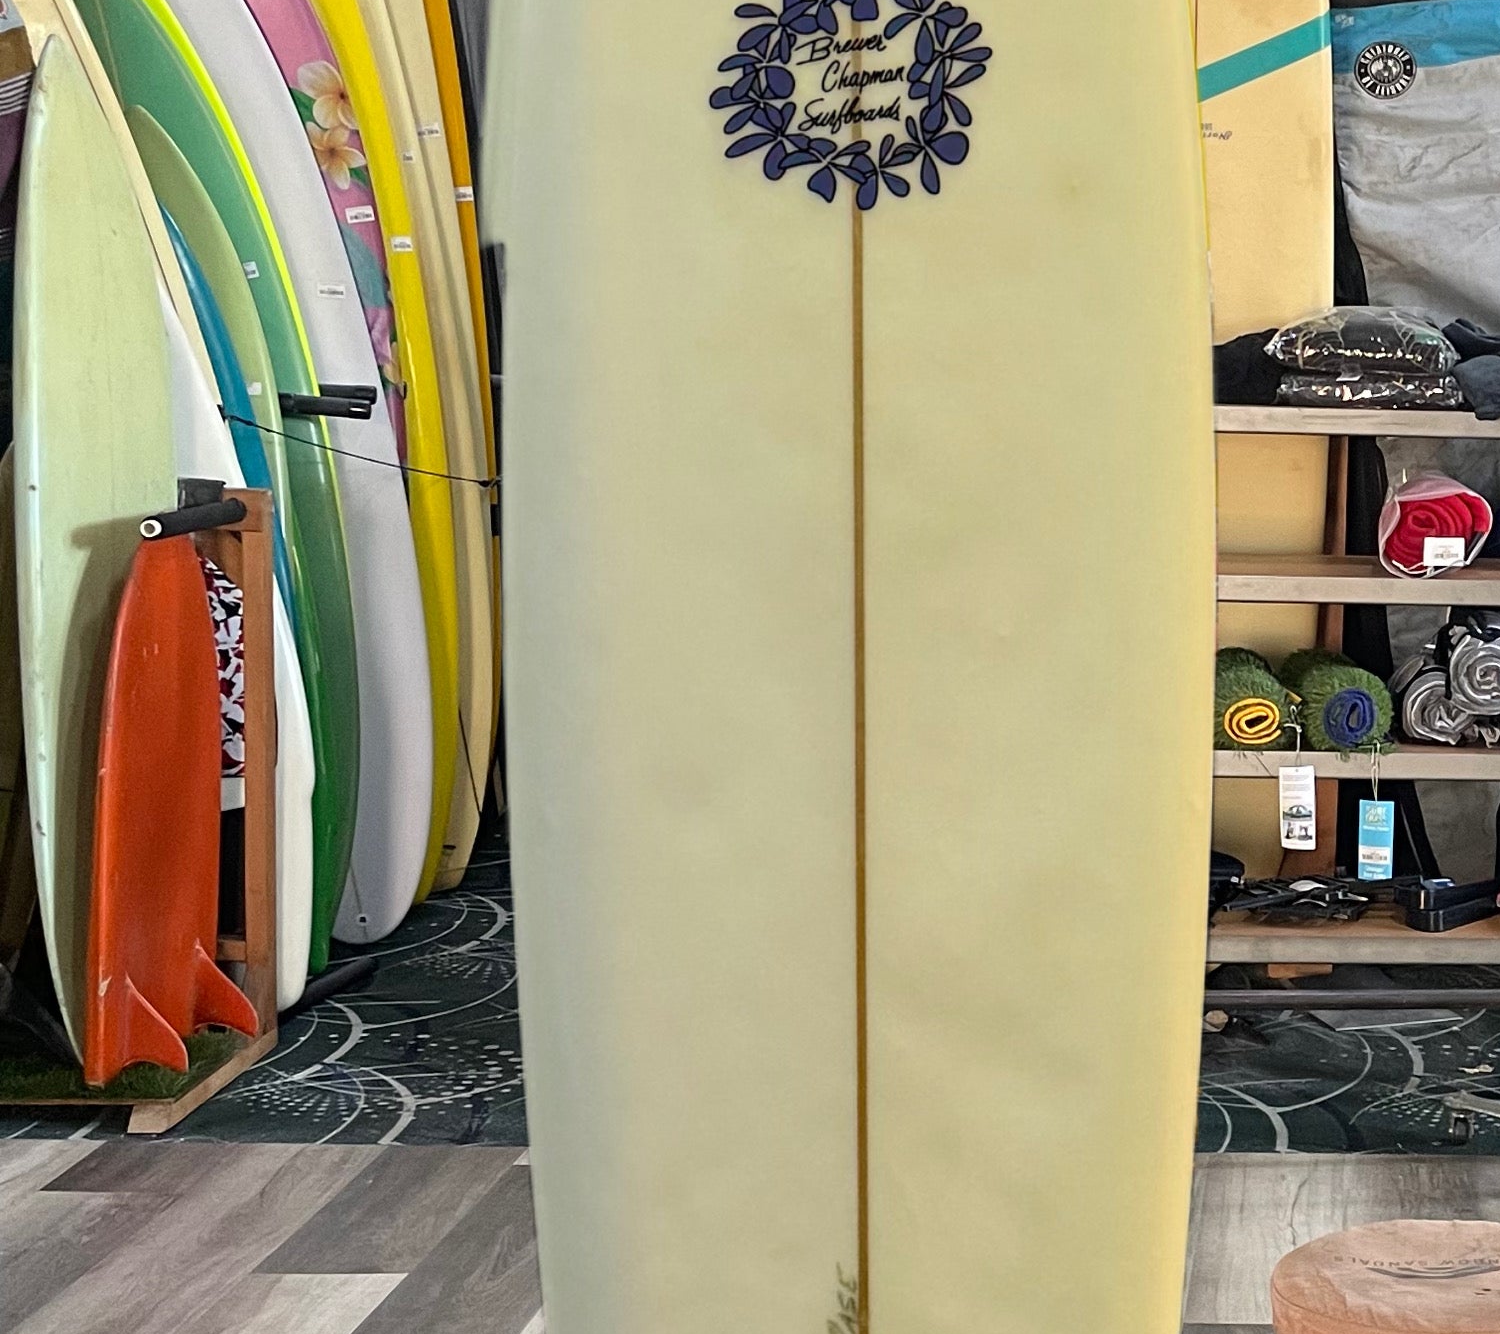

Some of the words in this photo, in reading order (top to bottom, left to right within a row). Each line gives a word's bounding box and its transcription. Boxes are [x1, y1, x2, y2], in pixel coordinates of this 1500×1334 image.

[795, 34, 887, 65] Brewer
[821, 60, 905, 94] Chapman
[798, 96, 901, 135] Surfboards
[1333, 1255, 1428, 1267] SANDALS
